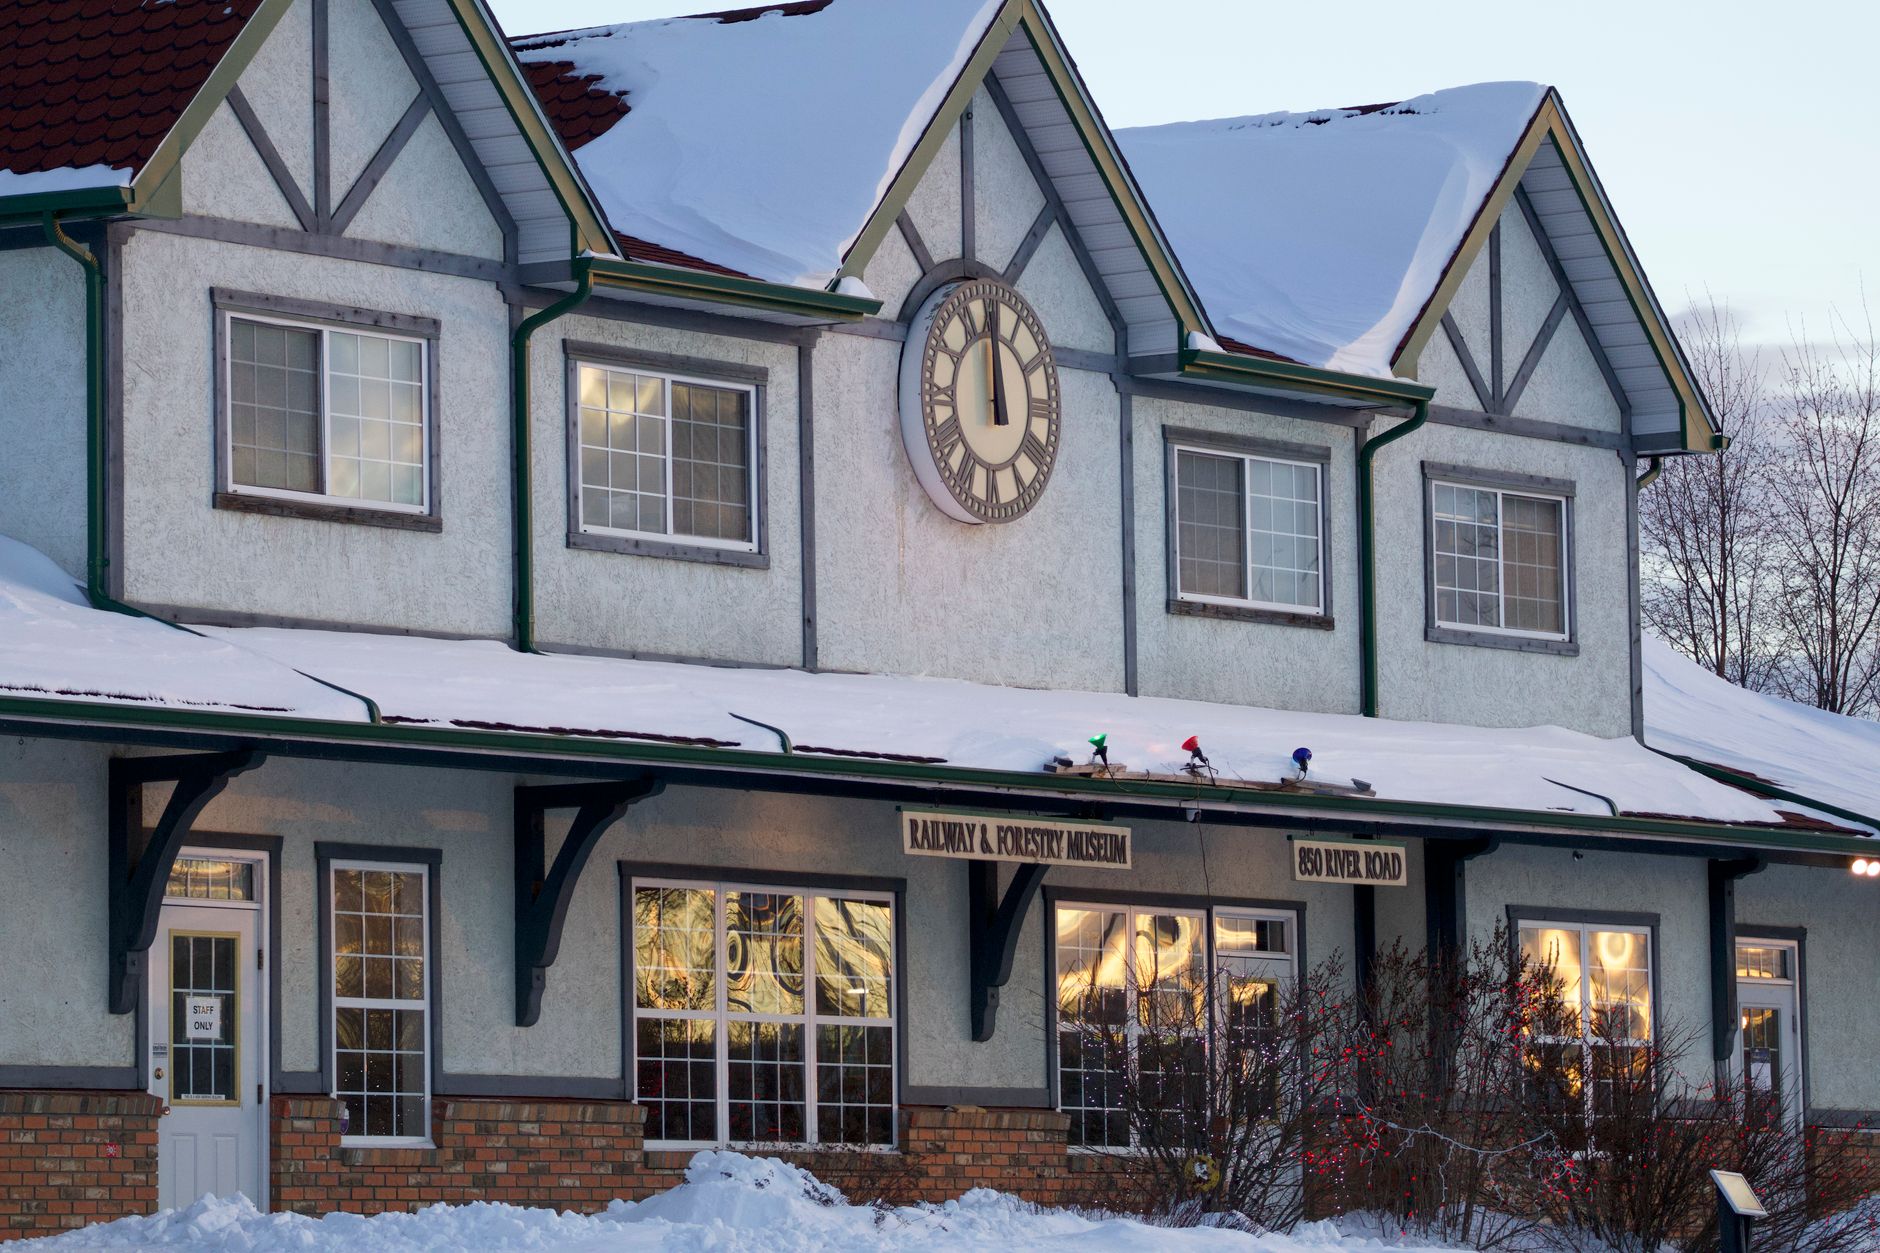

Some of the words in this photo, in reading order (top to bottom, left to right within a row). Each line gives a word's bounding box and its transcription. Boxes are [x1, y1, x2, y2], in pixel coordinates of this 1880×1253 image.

[909, 818, 977, 854] RAILWAY
[980, 824, 995, 854] &
[996, 824, 1064, 859] FORESTRY
[1066, 830, 1128, 864] MUSEUM
[1298, 846, 1323, 877] 850
[1324, 848, 1363, 879] RIVER
[1364, 850, 1402, 880] ROAD
[193, 1005, 214, 1015] STAFF
[194, 1021, 213, 1031] ONLY
